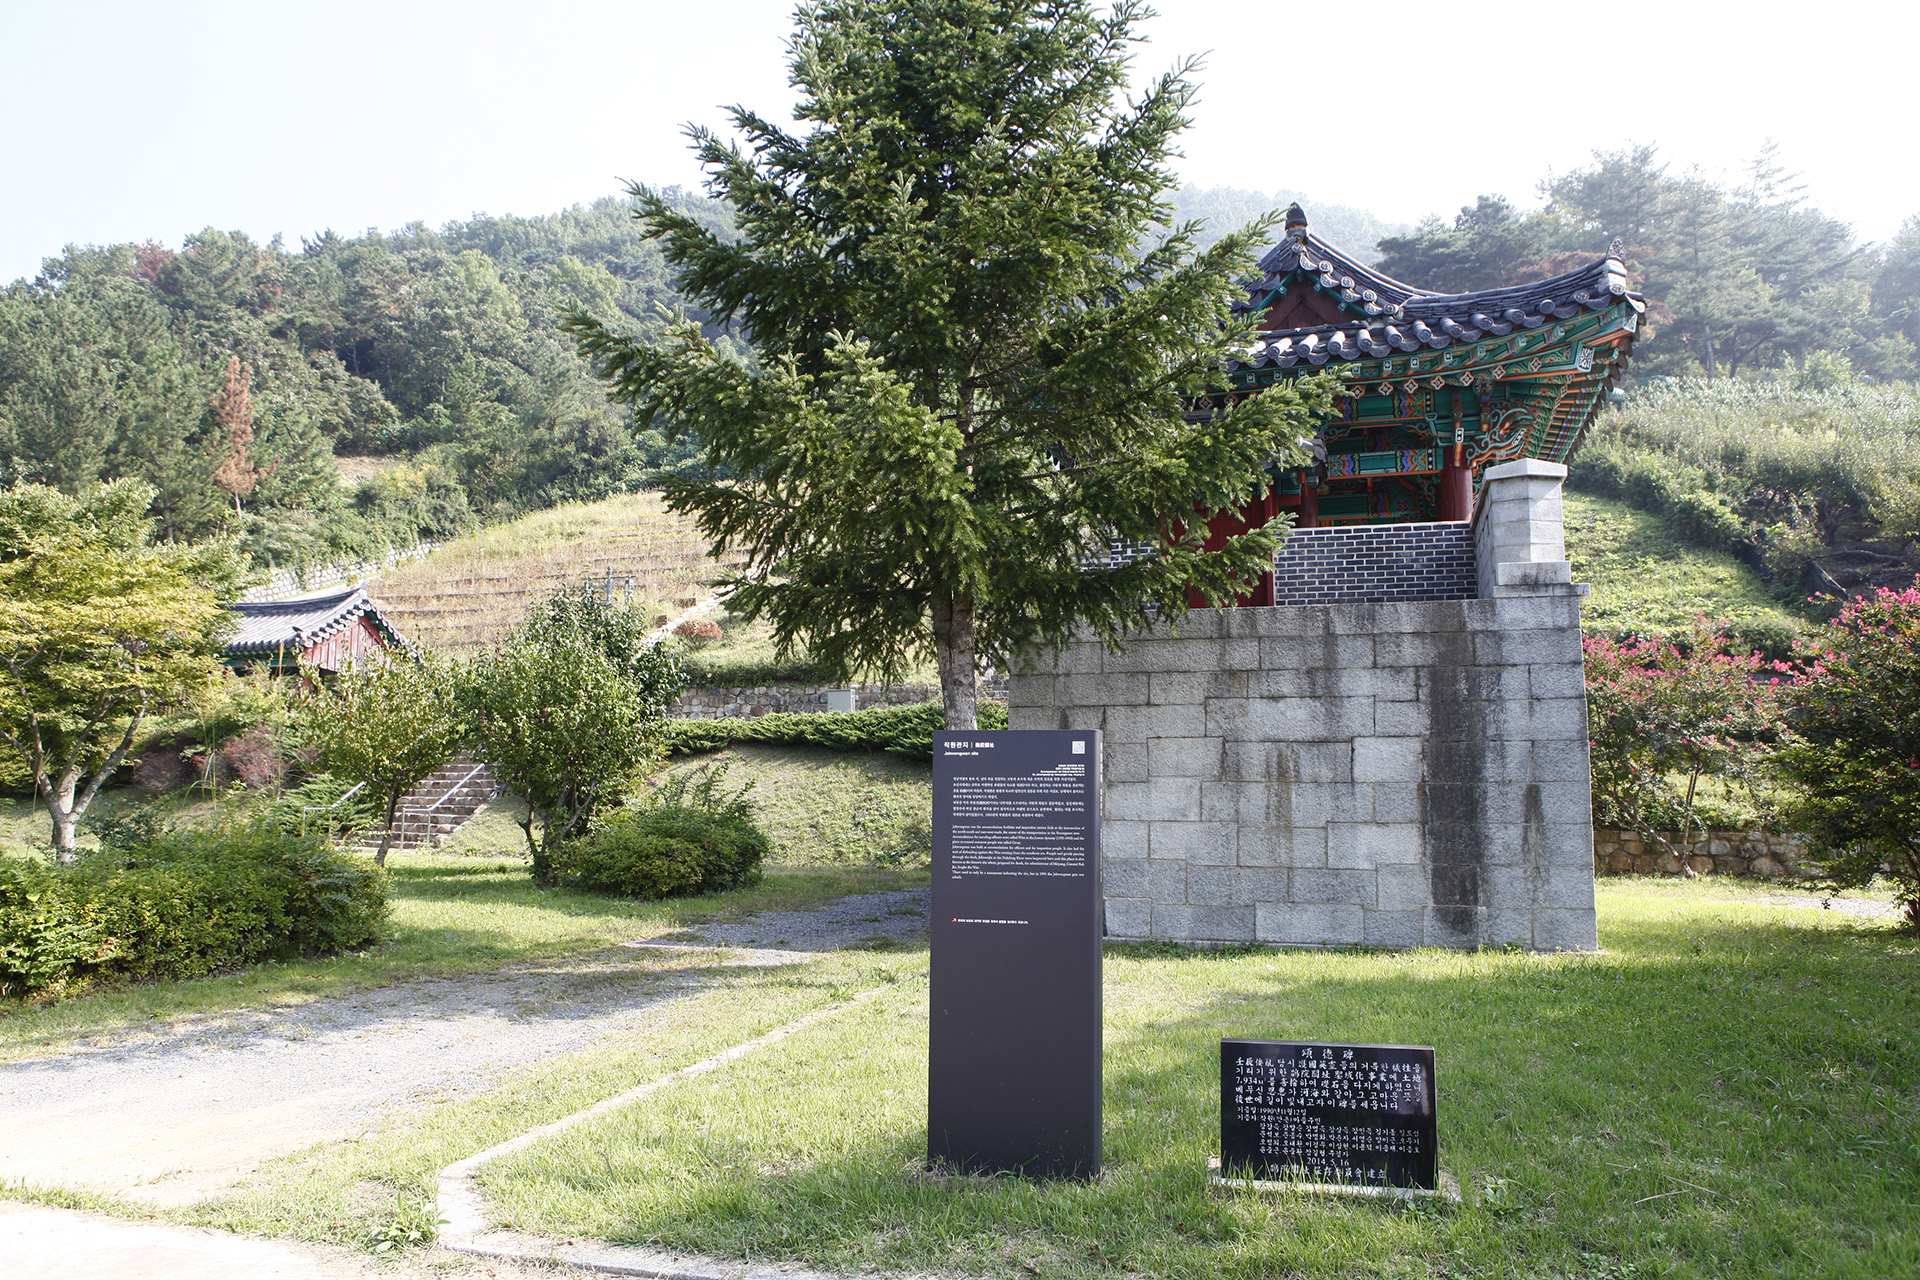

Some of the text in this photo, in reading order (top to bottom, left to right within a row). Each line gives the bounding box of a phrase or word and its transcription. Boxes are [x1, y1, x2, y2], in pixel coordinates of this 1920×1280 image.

[1278, 1058, 1295, 1068] 당시
[1361, 1062, 1388, 1072] 거룩한
[1236, 1066, 1263, 1076] 기리기
[1268, 1068, 1286, 1077] 위한
[1354, 1082, 1380, 1091] 다지게
[1235, 1086, 1264, 1095] 베푸신
[1334, 1090, 1352, 1100] 같아
[1357, 1091, 1365, 1100] 그
[1370, 1092, 1398, 1102] 고마운
[1266, 1096, 1284, 1106] 길이
[1328, 1098, 1336, 1108] 이
